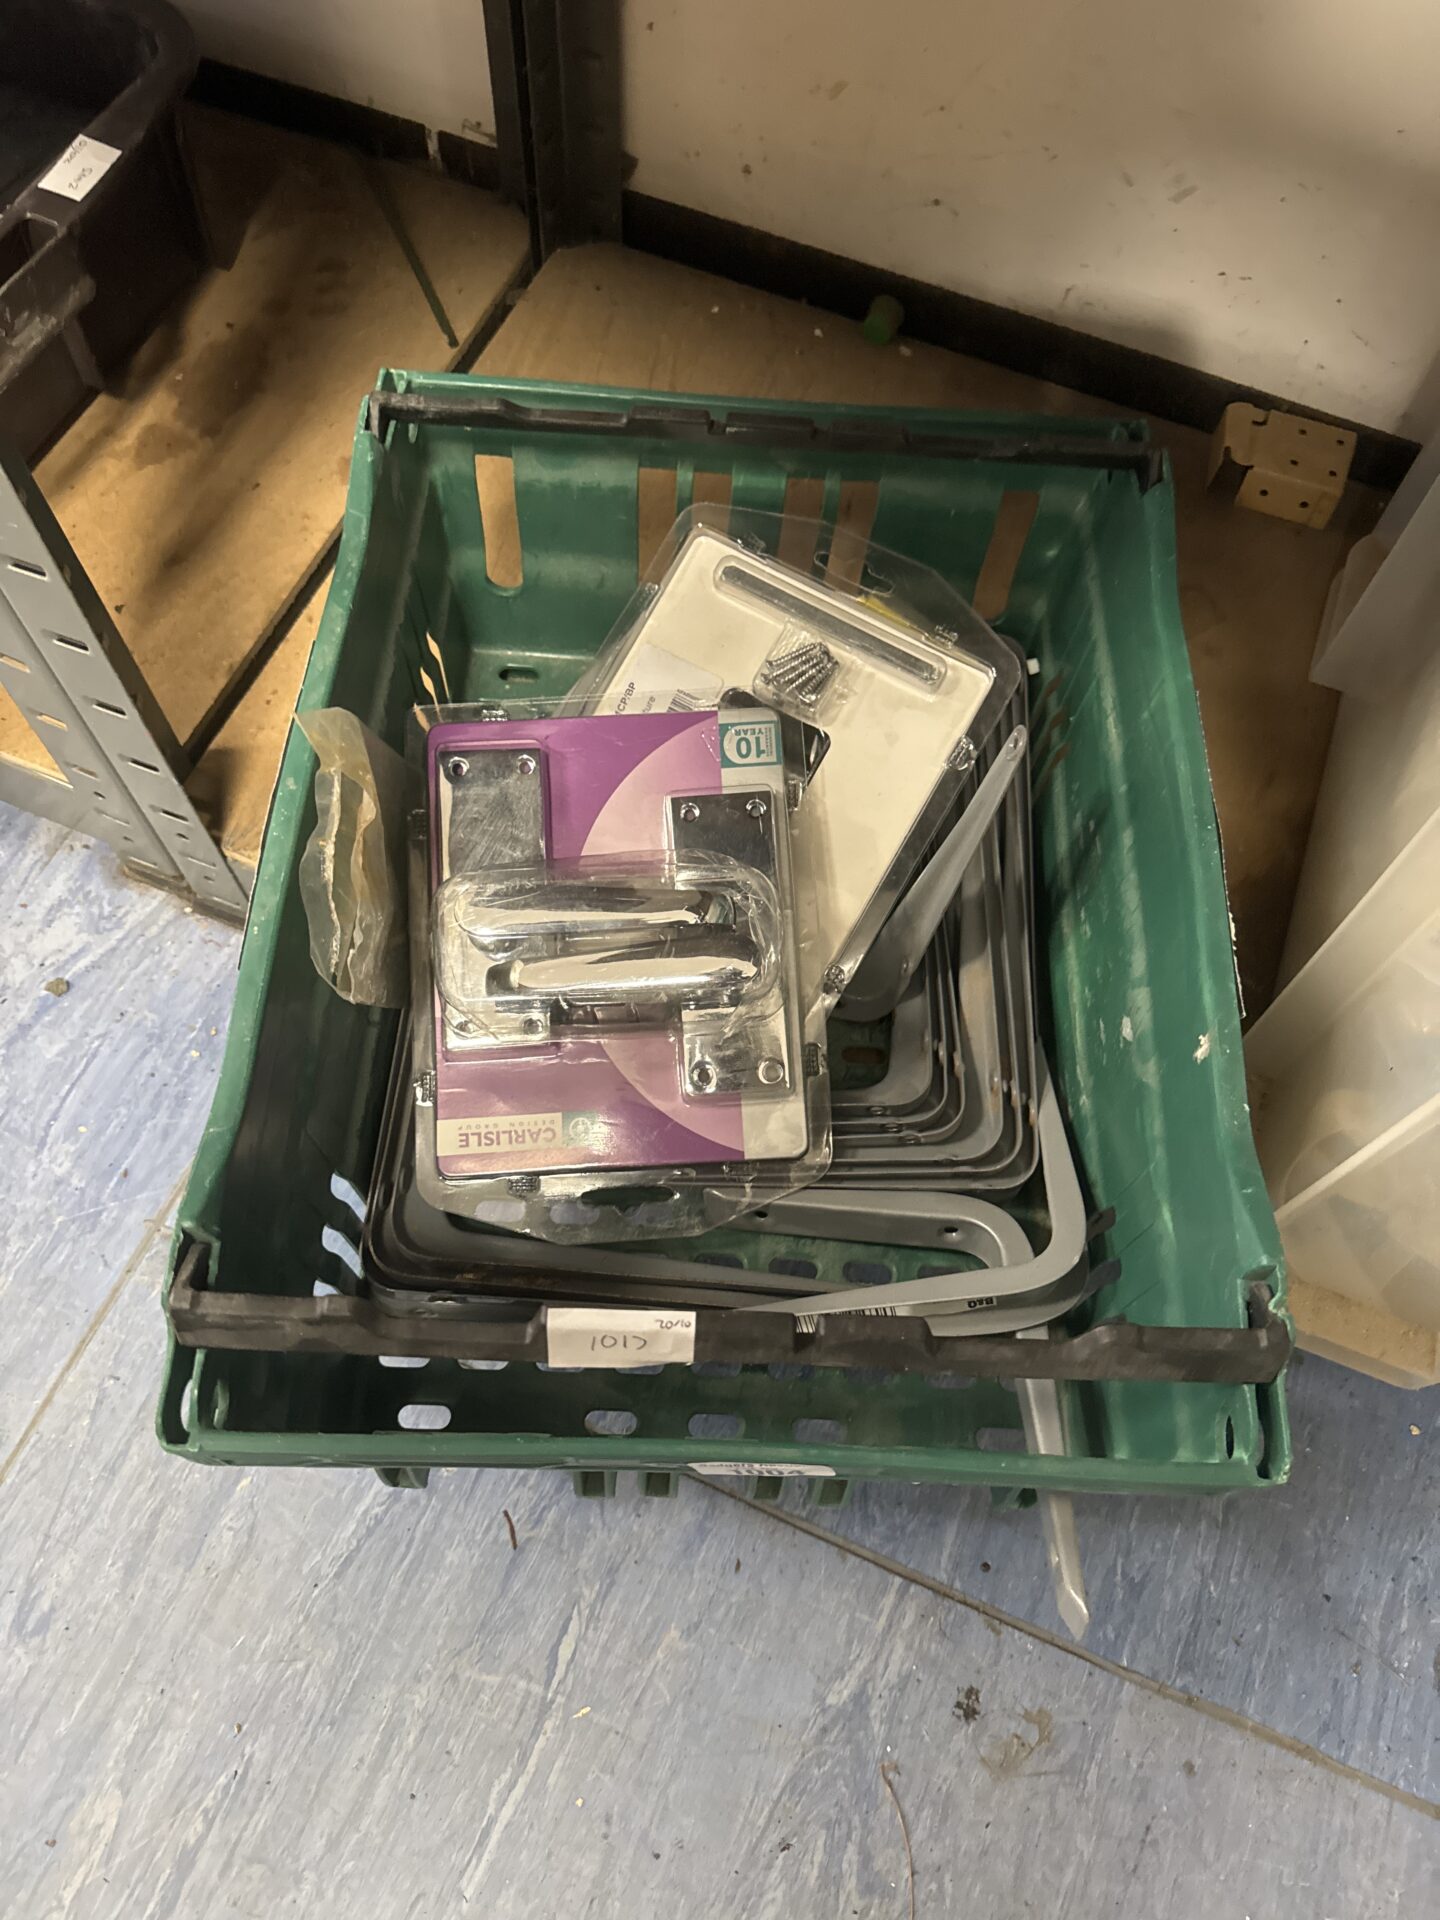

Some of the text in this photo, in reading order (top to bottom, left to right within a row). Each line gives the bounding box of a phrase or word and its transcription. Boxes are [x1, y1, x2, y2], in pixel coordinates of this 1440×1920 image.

[734, 727, 764, 736] YEAR
[735, 735, 766, 759] 10
[457, 1119, 556, 1131] DESIGN GROUP
[458, 1127, 557, 1149] CARLISLE
[967, 1296, 994, 1309] B&Q
